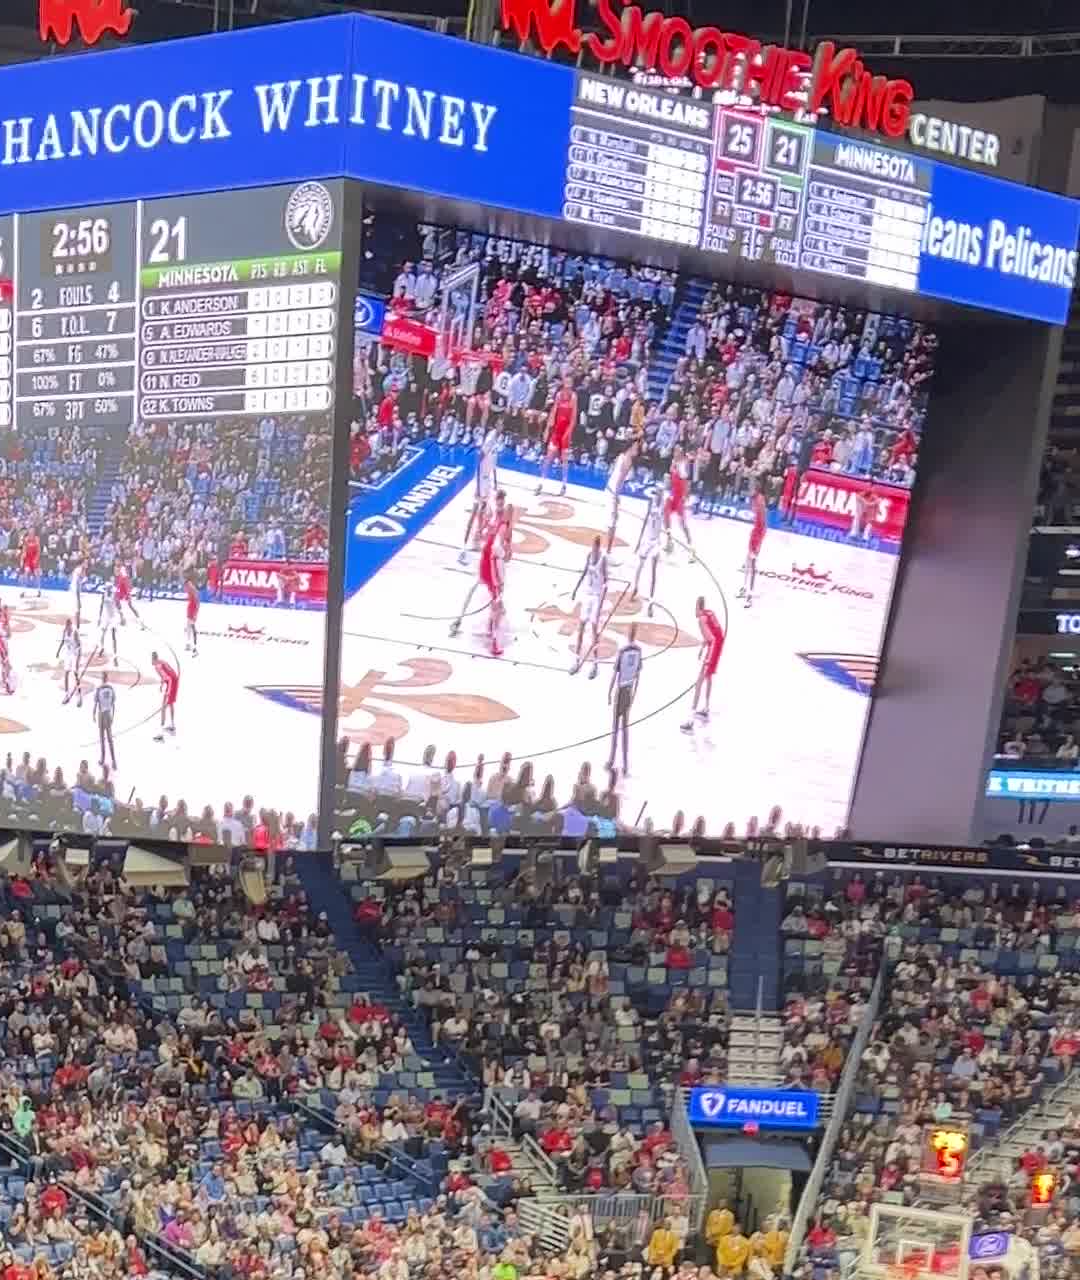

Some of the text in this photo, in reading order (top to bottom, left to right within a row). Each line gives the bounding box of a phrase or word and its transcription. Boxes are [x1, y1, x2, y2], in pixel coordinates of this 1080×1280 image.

[581, 78, 710, 129] NEW ORLEANS
[2, 73, 499, 165] HANCOCK WHITNEY
[728, 124, 753, 155] 25
[776, 136, 798, 165] 21
[909, 112, 1000, 167] CENTER
[835, 142, 916, 183] MINNESOTA
[52, 219, 109, 257] 2:56
[149, 216, 187, 263] 21
[984, 219, 1078, 288] Pelicans
[159, 264, 238, 288] MINNESOTA
[31, 281, 120, 309] 2 FOULS 4
[173, 295, 238, 313] ANDERSON
[31, 317, 43, 337] 6
[106, 311, 117, 332] 7
[174, 321, 232, 337] EDWARDS
[68, 344, 82, 363] FG
[69, 373, 82, 391] FT
[172, 373, 200, 387] REID
[172, 397, 215, 411] TOWNS
[386, 464, 465, 518] FANDUEL
[884, 847, 988, 863] BETRIVERS
[727, 1098, 808, 1117] FANDUEL
